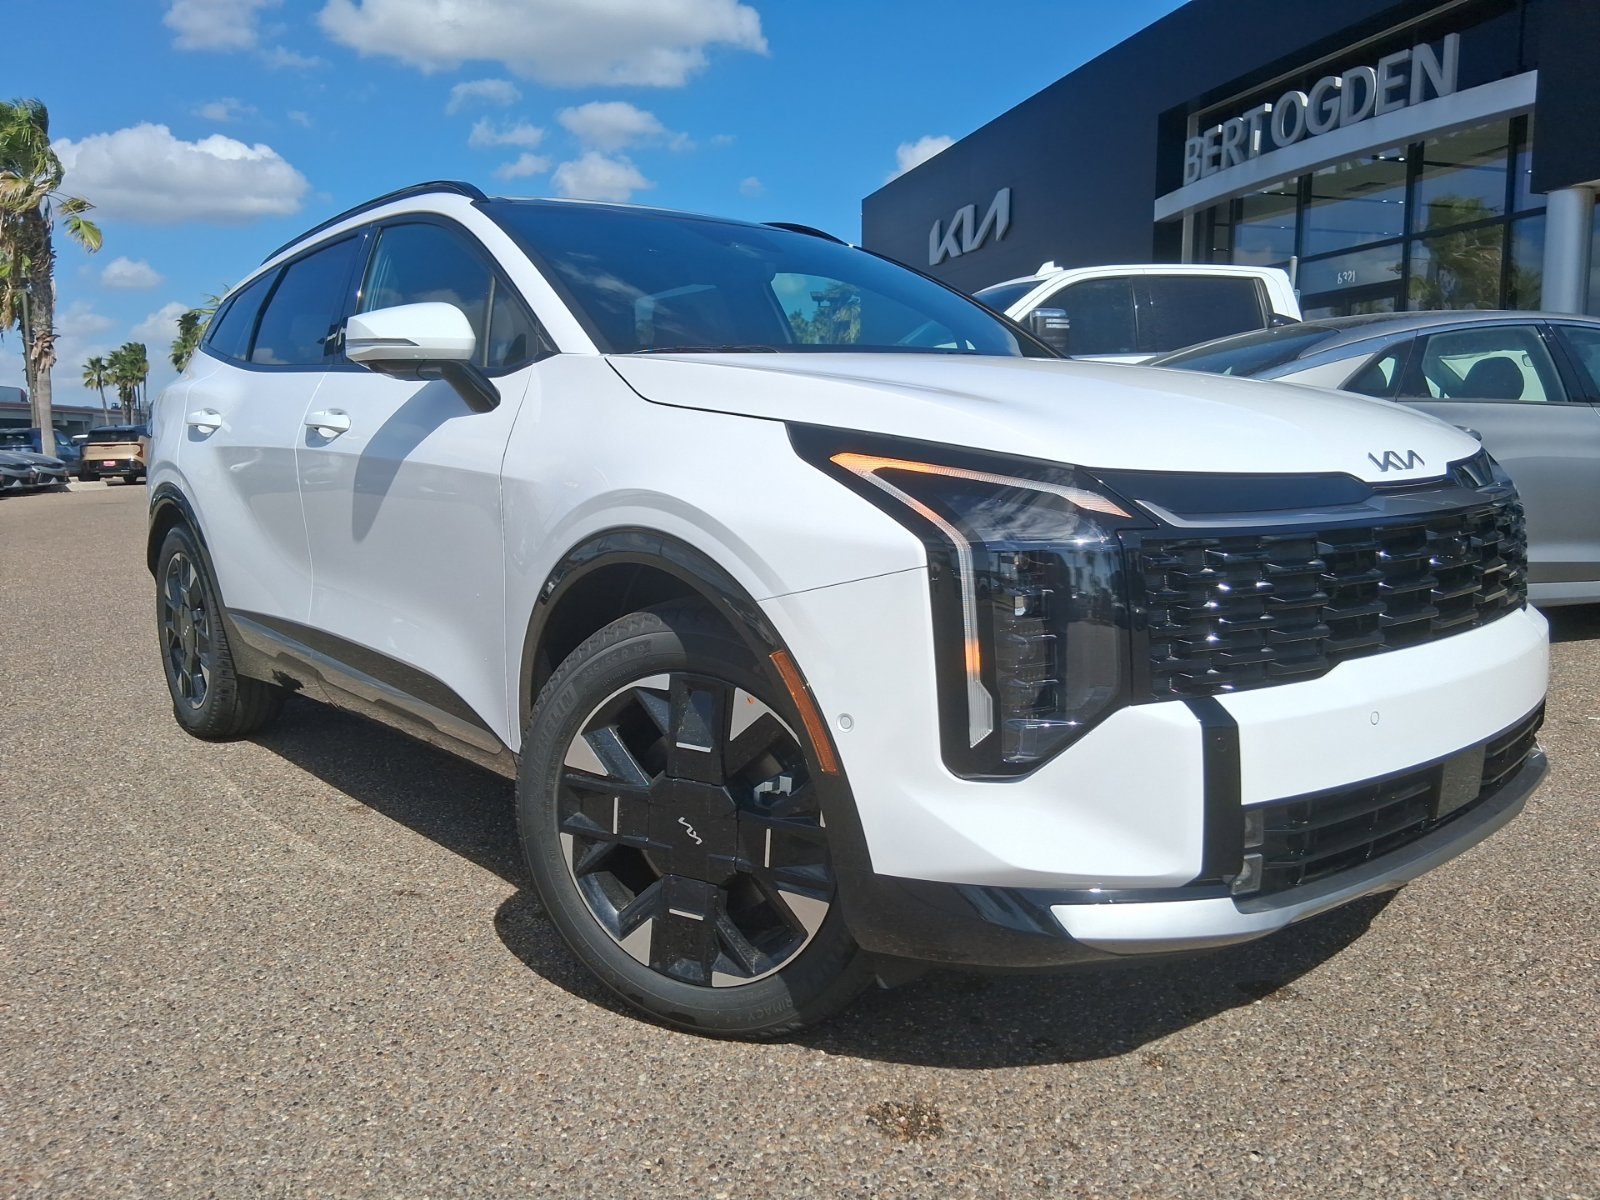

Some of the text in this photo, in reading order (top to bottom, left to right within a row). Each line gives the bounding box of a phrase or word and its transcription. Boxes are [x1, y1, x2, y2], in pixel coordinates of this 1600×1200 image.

[1183, 33, 1460, 187] BERT OGDEN
[928, 187, 1010, 266] KIA
[1367, 449, 1425, 472] KIA
